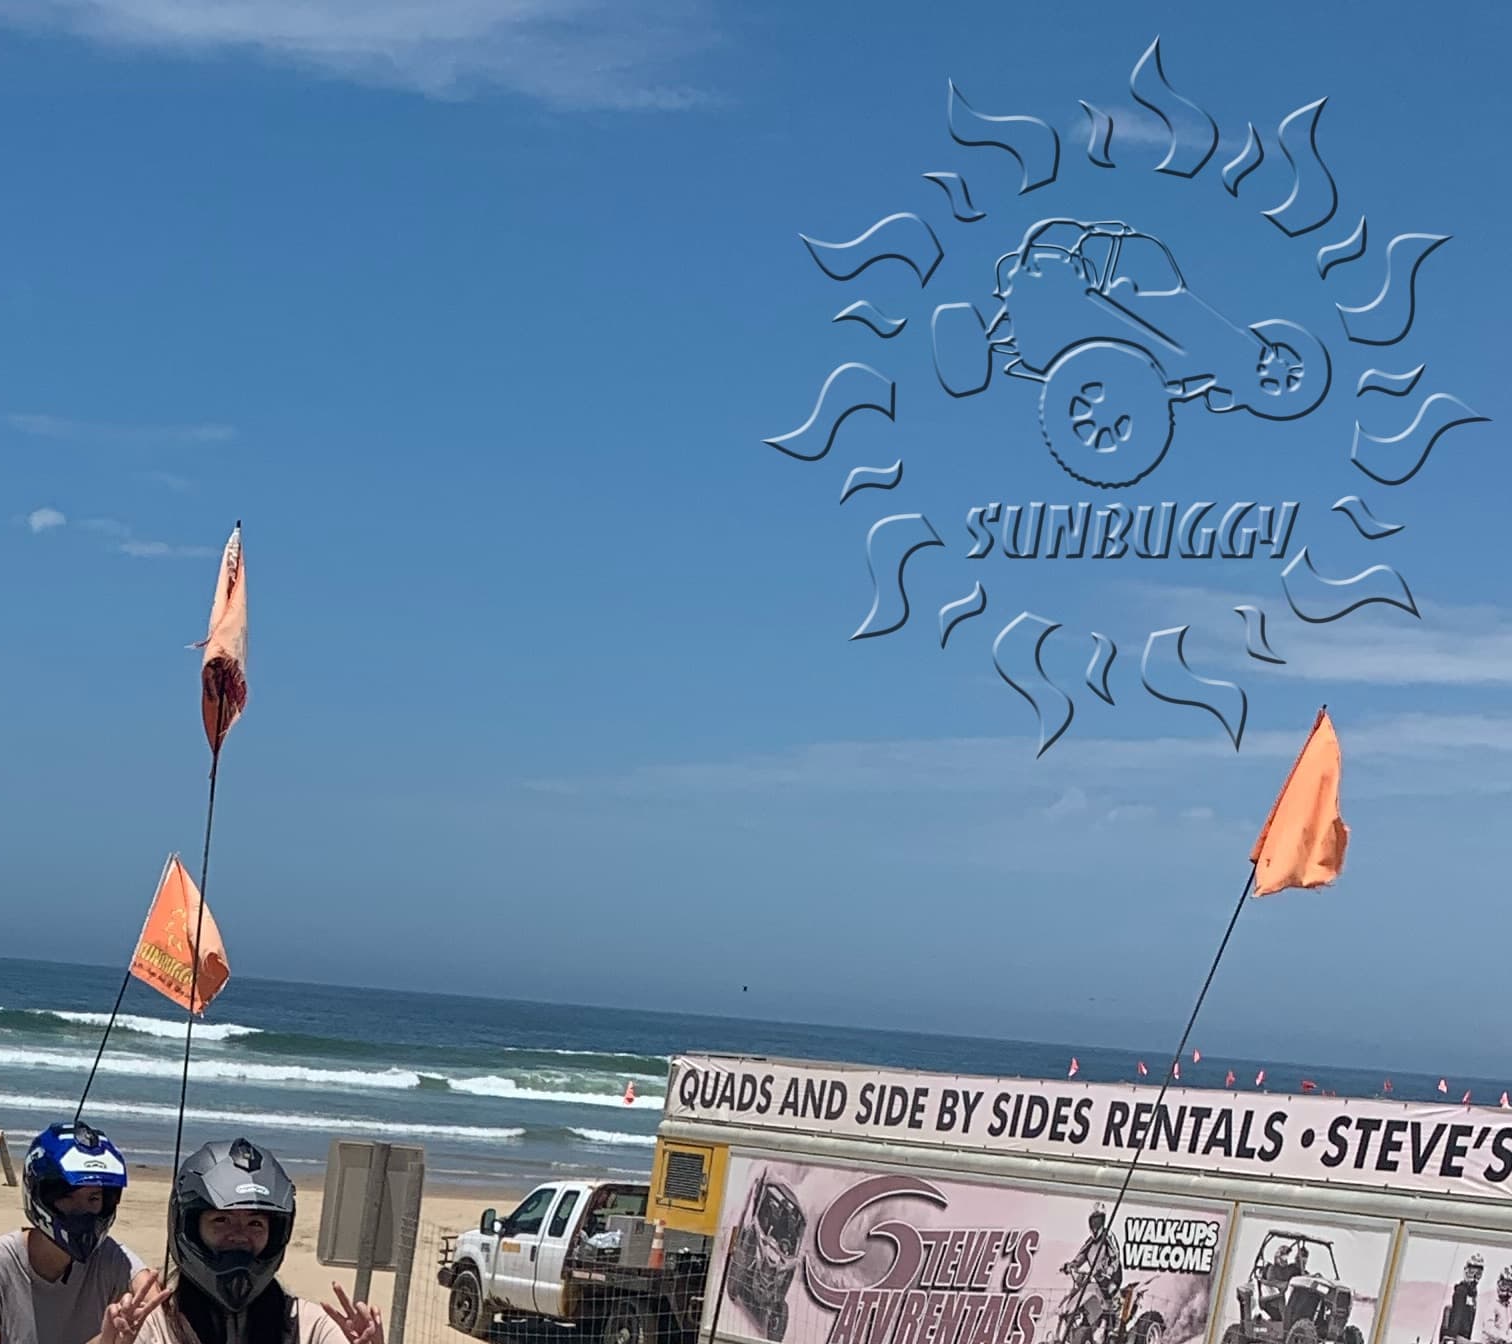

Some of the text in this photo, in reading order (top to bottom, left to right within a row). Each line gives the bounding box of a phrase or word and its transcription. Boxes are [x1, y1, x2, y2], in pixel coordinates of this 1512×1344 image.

[679, 1069, 1512, 1183] QUADS AND SIDE BY SIDES RENTALS STEVE'S
[1126, 1218, 1220, 1247] WALK-UPS
[1124, 1243, 1214, 1272] WELCOME
